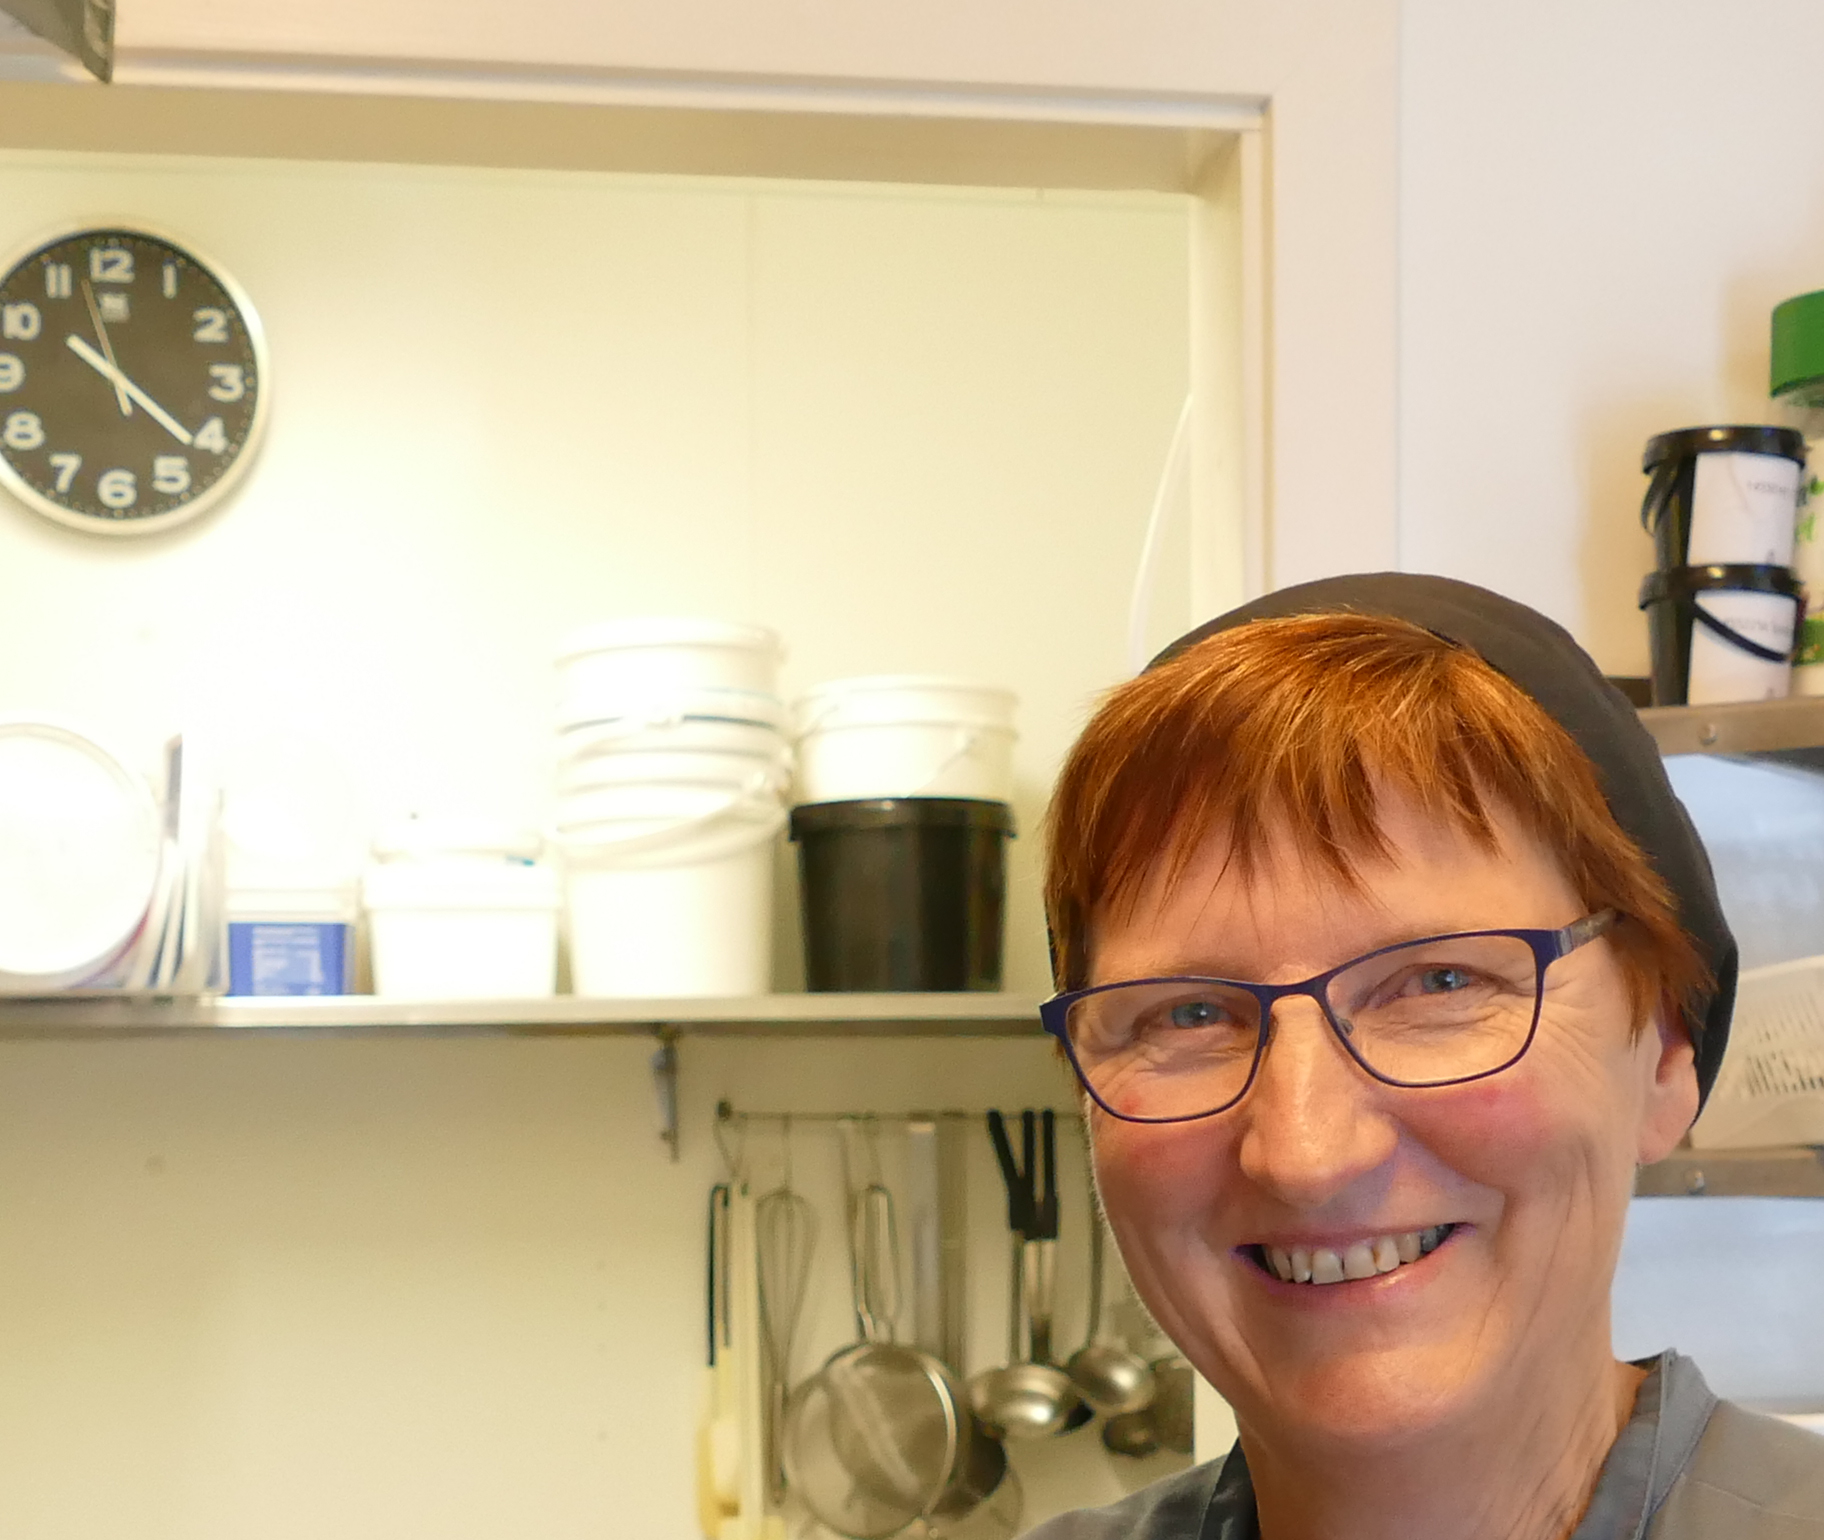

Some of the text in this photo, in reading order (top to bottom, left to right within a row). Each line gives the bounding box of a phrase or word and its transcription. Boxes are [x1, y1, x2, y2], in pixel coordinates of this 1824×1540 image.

[45, 263, 72, 299] 11
[89, 247, 134, 283] 12
[161, 262, 178, 299] 1
[2, 302, 41, 341] 10
[192, 306, 229, 343] 2
[207, 363, 245, 402] 3
[3, 411, 46, 451] 8
[192, 416, 229, 455] 4
[49, 453, 84, 494] 7
[97, 469, 138, 510] 6
[152, 456, 192, 494] 5
